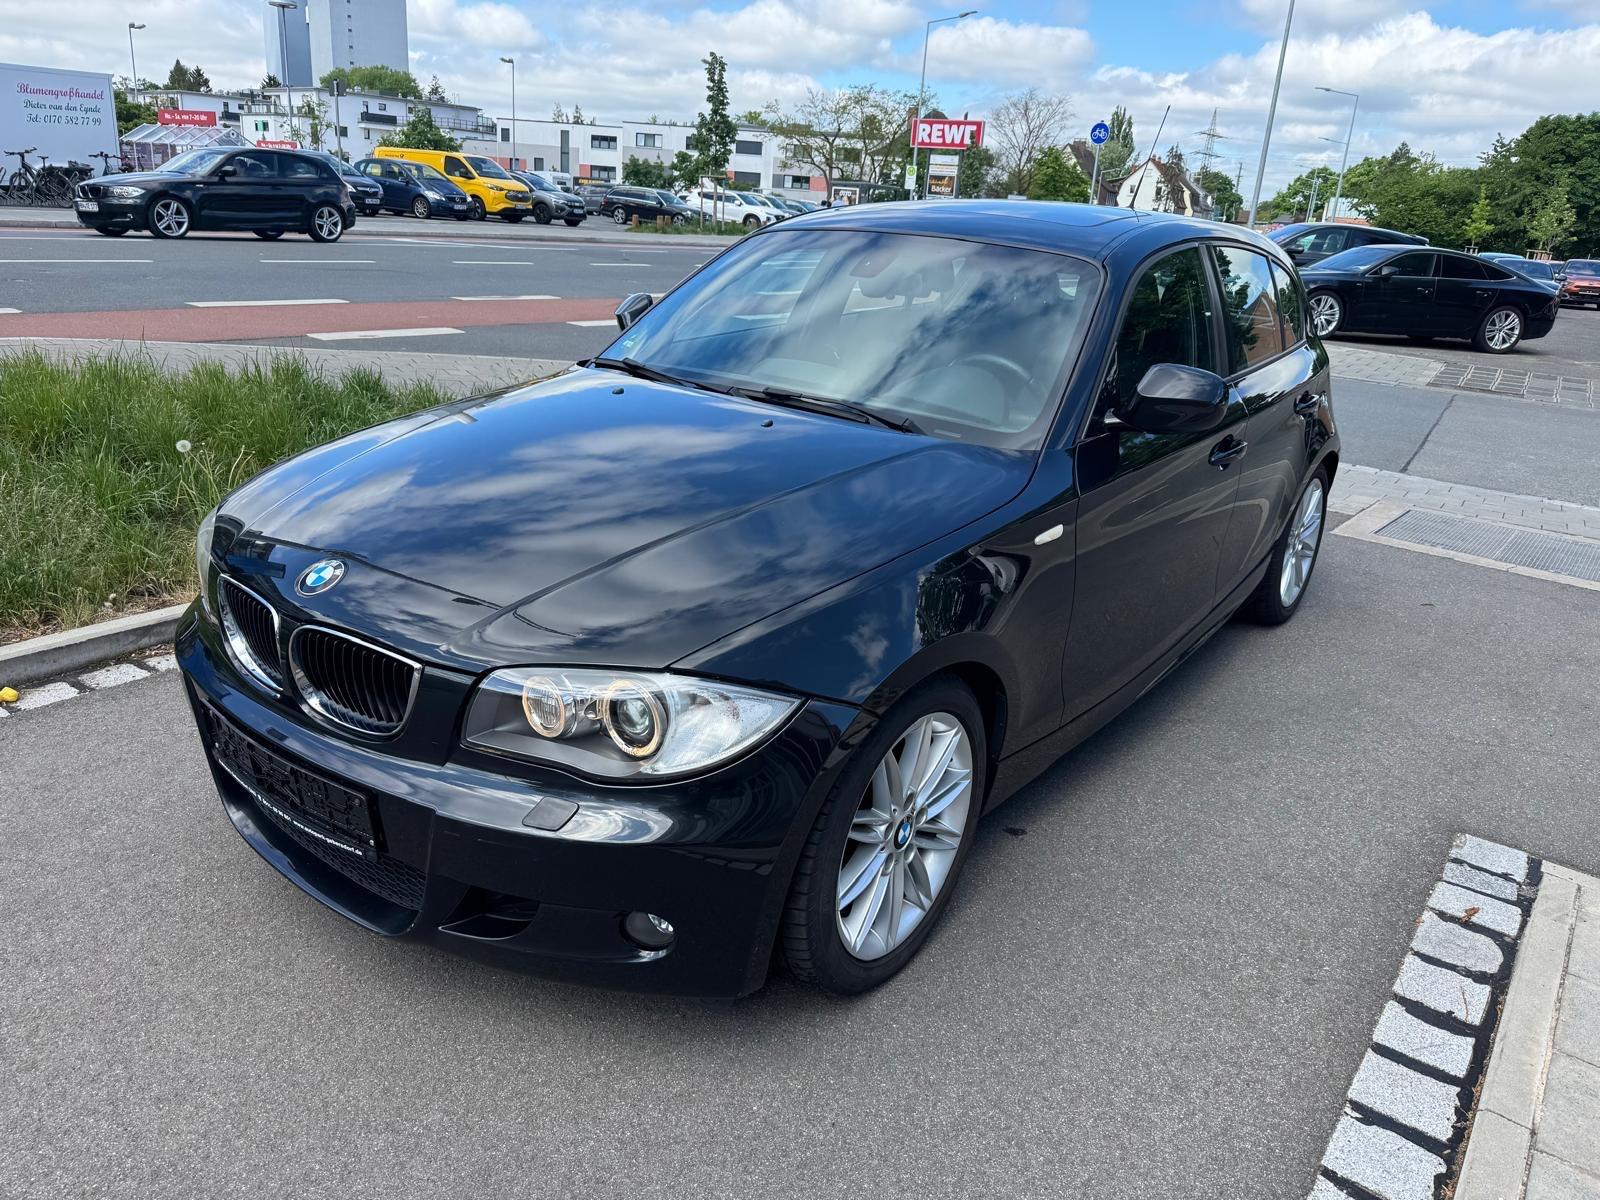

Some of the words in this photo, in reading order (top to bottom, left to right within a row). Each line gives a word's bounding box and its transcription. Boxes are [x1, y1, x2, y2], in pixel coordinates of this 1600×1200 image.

[16, 82, 105, 100] Blumengroßhandel
[23, 99, 47, 110] Dieter
[48, 103, 63, 111] van
[64, 102, 78, 112] den
[79, 104, 102, 114] Eynde
[43, 114, 63, 125] 0170
[64, 115, 79, 126] 582
[81, 116, 90, 127] 77
[91, 117, 102, 127] 99
